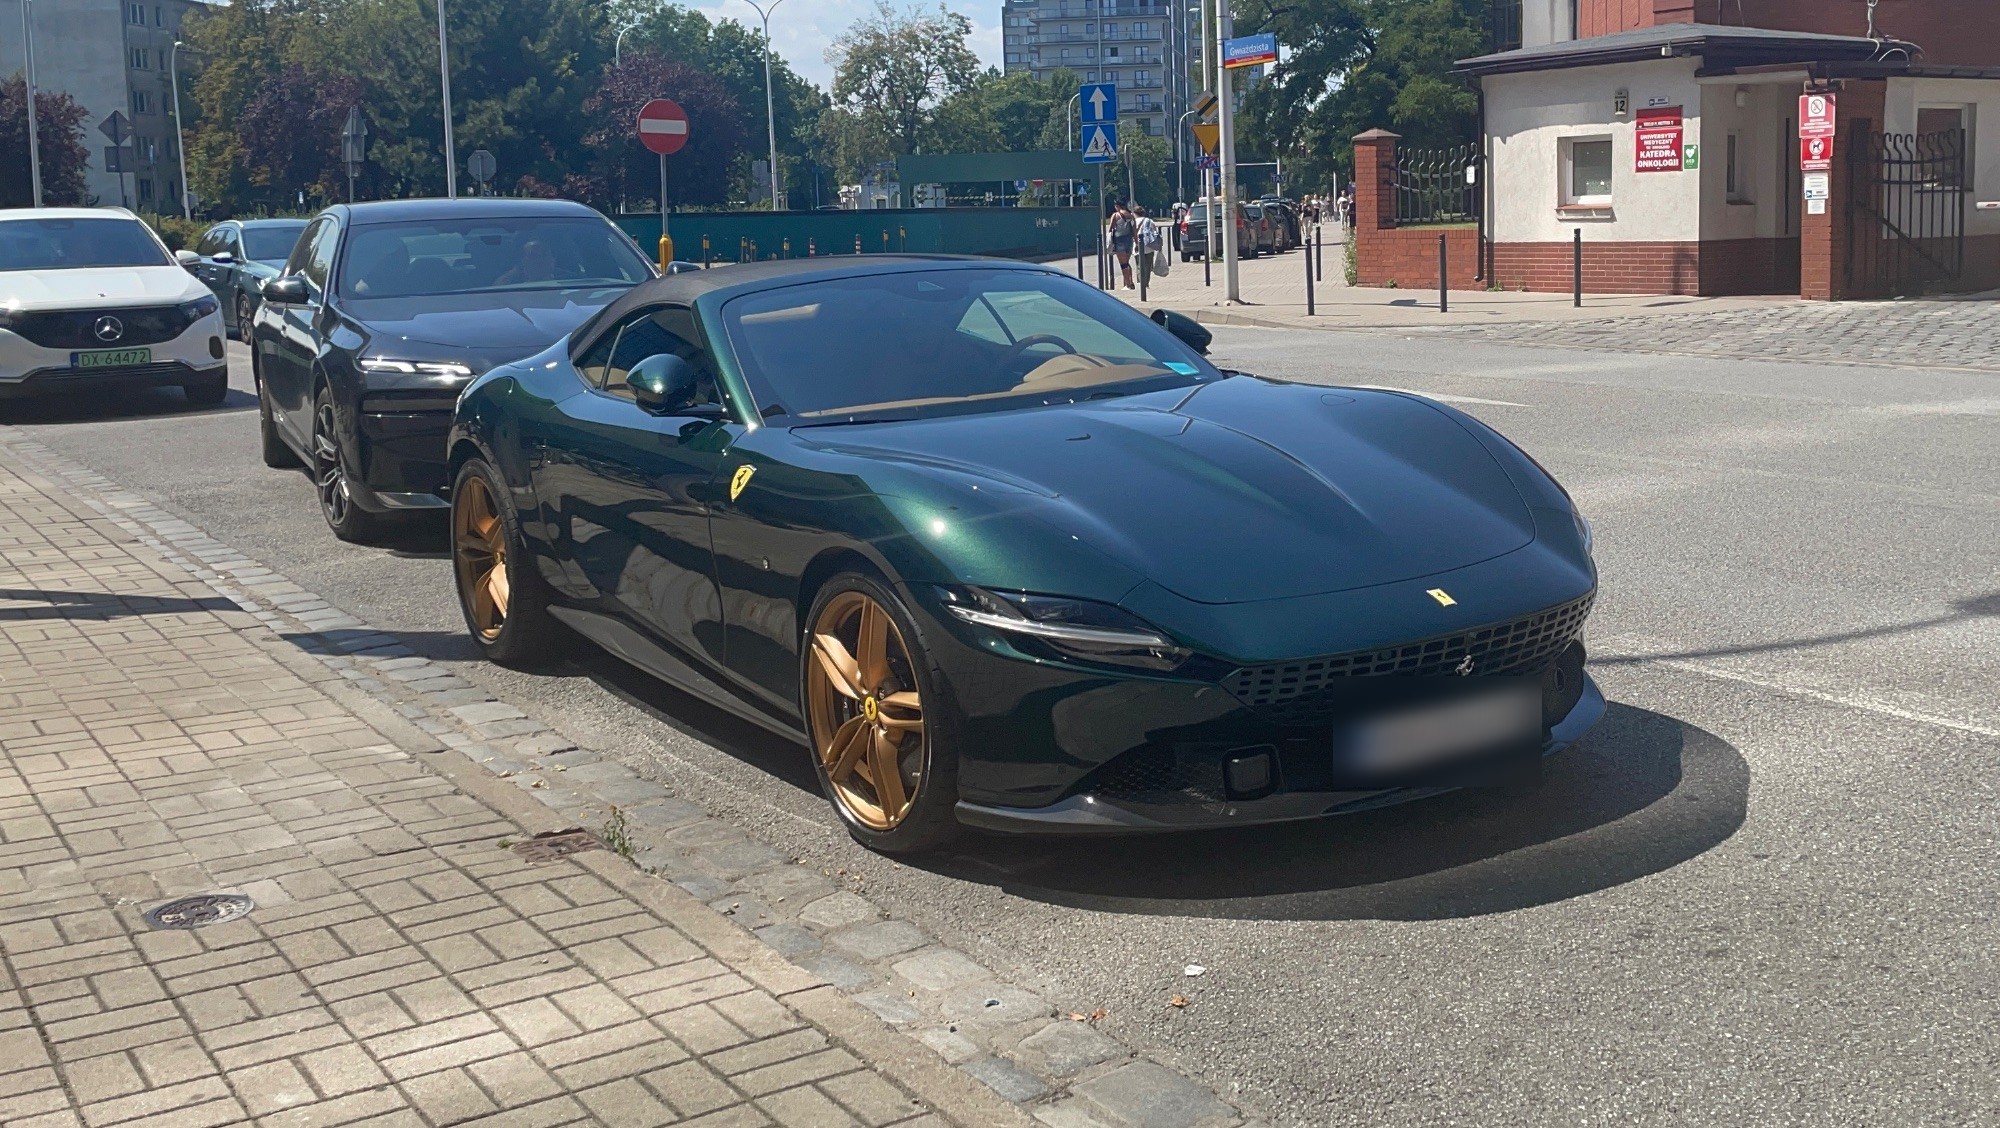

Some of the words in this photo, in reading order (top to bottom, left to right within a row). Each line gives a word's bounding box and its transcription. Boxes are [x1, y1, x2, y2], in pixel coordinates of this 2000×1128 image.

[1615, 100, 1625, 111] 12
[1640, 150, 1676, 158] KATEDRA
[1637, 159, 1679, 168] ONKOLOGII
[81, 353, 99, 366] DX
[105, 351, 146, 365] 64472
